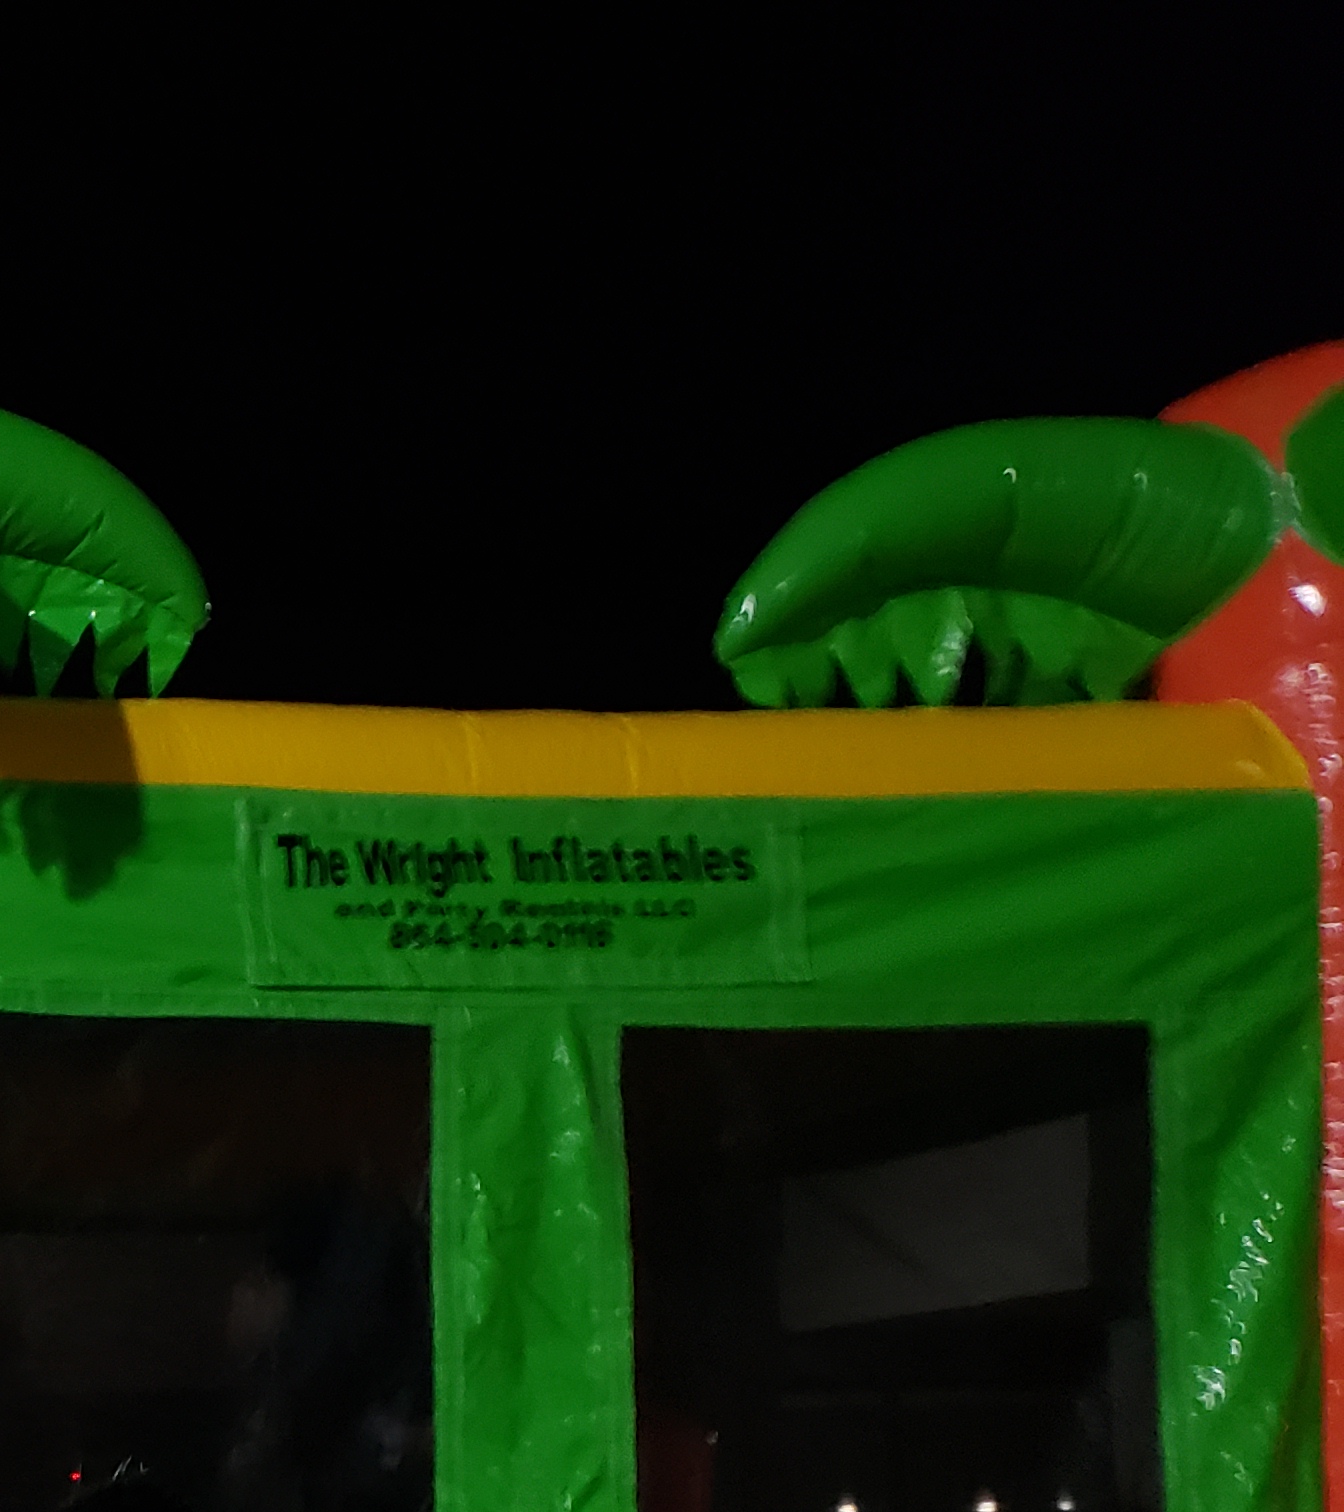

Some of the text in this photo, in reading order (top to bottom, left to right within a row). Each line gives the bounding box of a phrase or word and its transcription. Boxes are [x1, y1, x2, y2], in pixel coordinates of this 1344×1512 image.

[277, 833, 757, 898] The Wright Inflatables
